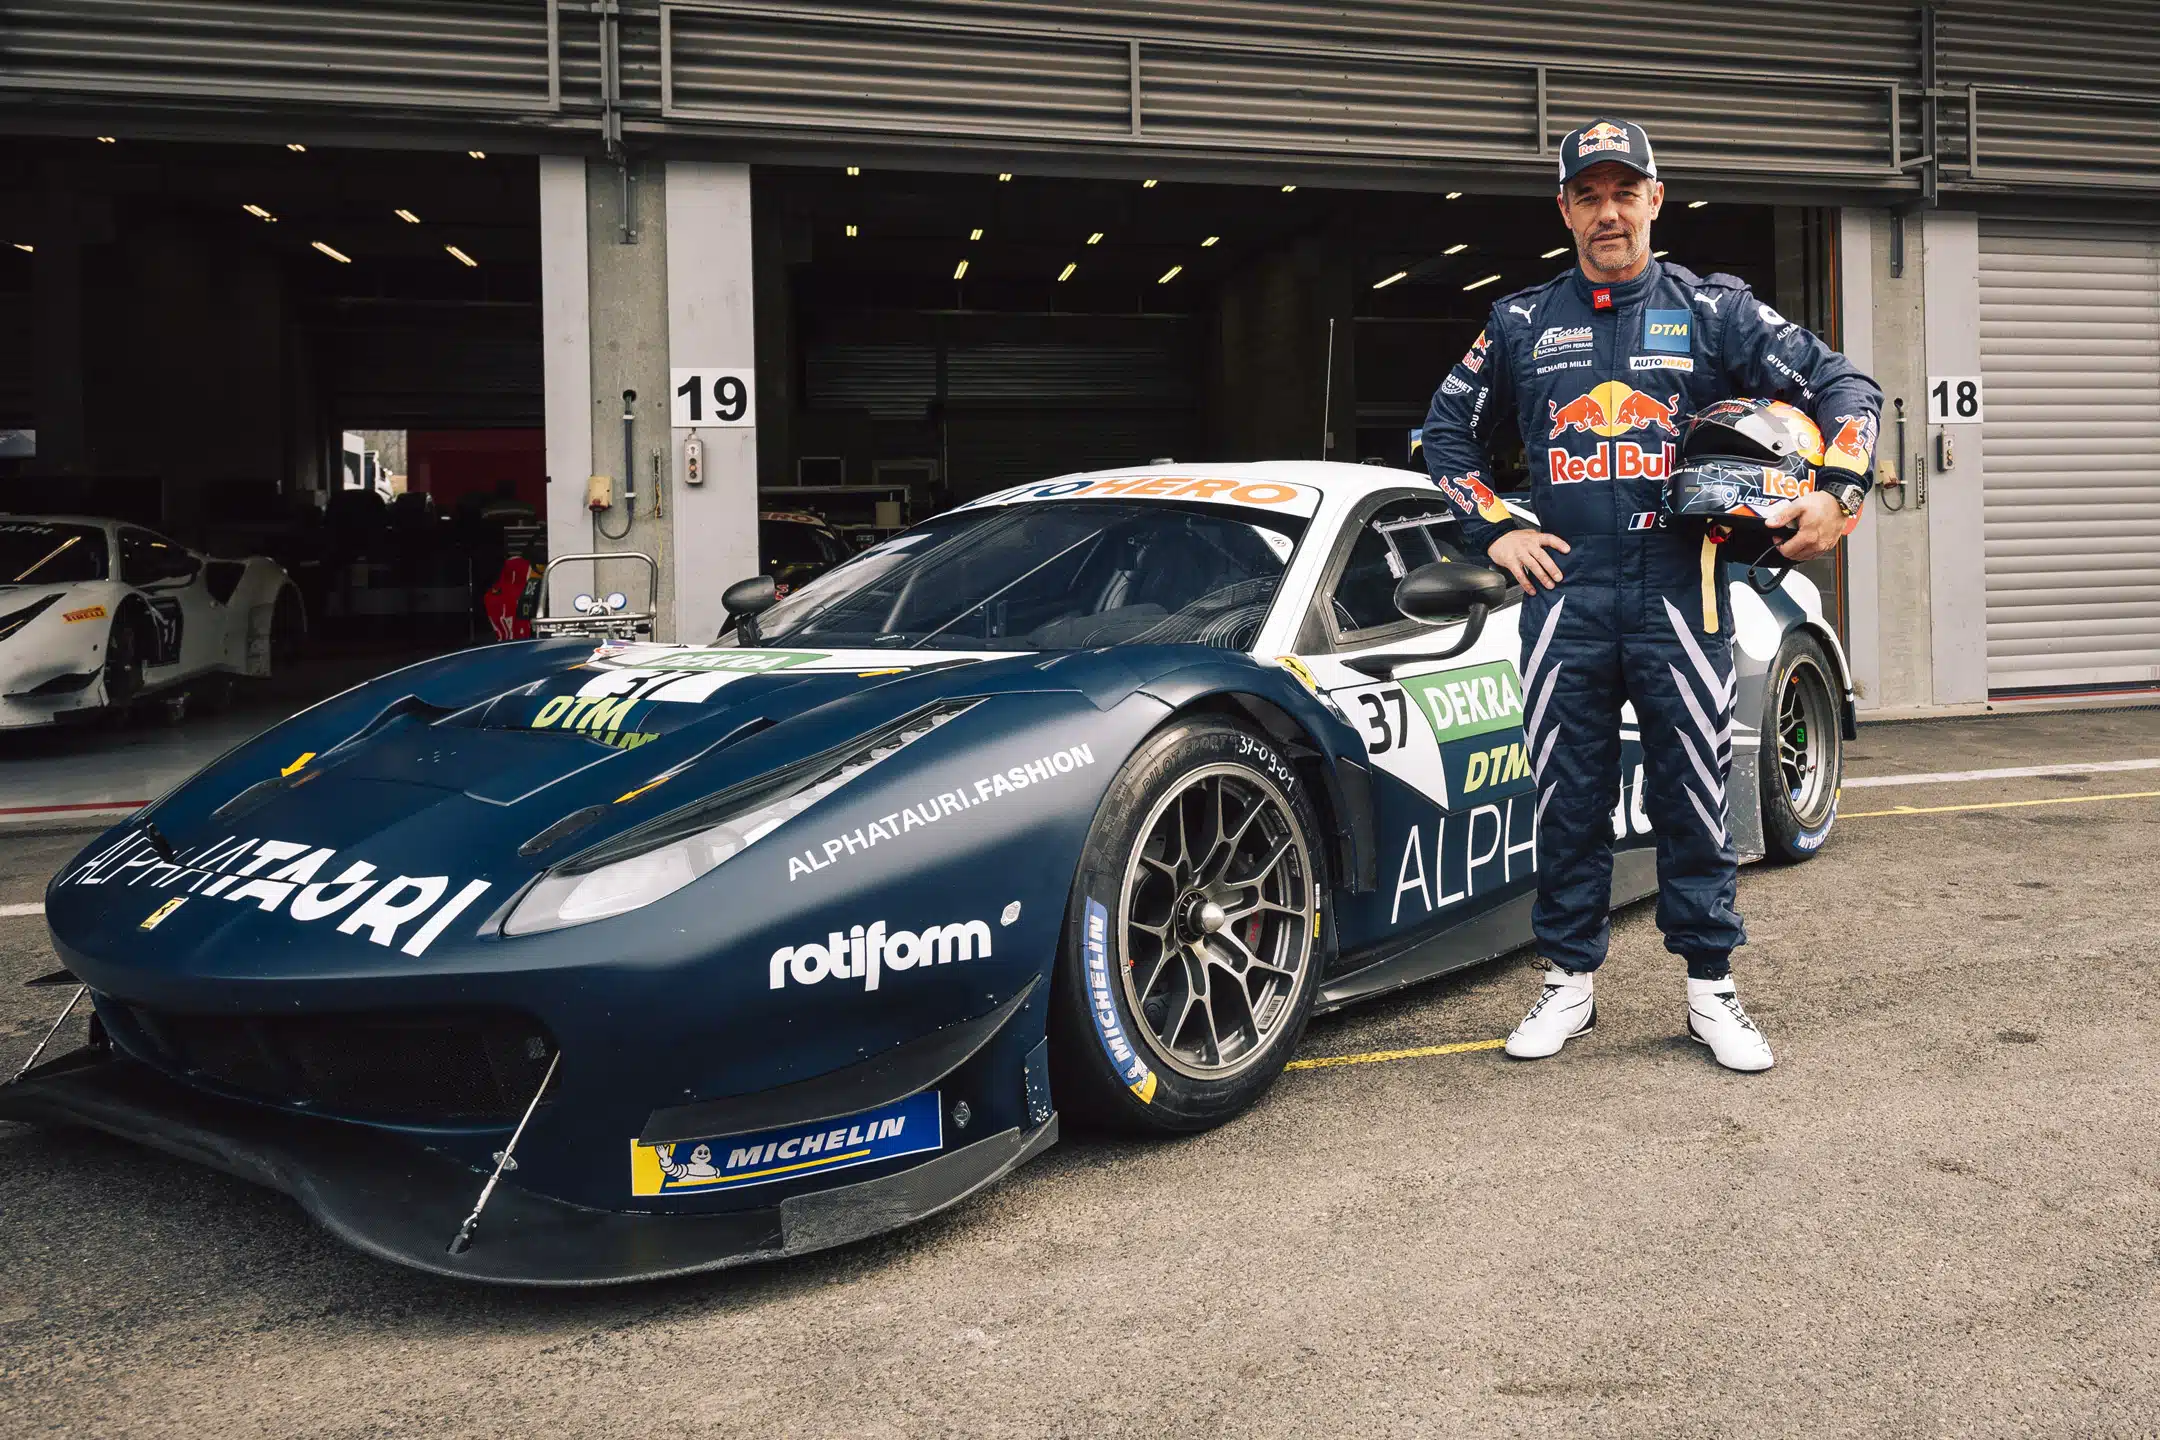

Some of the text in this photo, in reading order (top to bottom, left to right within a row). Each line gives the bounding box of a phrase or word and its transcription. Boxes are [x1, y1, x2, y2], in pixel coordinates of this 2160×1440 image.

[1579, 139, 1630, 157] Red Bull
[1597, 294, 1610, 303] SFR
[1650, 323, 1687, 336] DTM
[1537, 360, 1592, 375] RICHARD MILLE
[1634, 358, 1692, 369] AUTOHERO
[1766, 354, 1808, 387] GIVES YOU
[677, 376, 747, 421] 19
[1932, 381, 1978, 417] 18
[1469, 414, 1479, 429] OU
[1548, 441, 1676, 485] Red Bull
[1439, 475, 1474, 515] Red Bull
[1761, 467, 1816, 499] Red
[63, 607, 104, 622] PIRELLI
[652, 653, 790, 669] DEKRA
[531, 696, 640, 729] DTM
[1423, 672, 1523, 731] DEKRA
[1357, 688, 1408, 755] 37
[1142, 750, 1181, 793] PILOT
[1464, 743, 1532, 794] DTM
[787, 743, 1095, 882] ALPHATAURI.FASHION
[1391, 799, 1537, 924] ALPH
[770, 919, 992, 992] rotiform
[1089, 915, 1132, 1063] MICHELIN
[726, 1116, 906, 1169] MICHELIN
